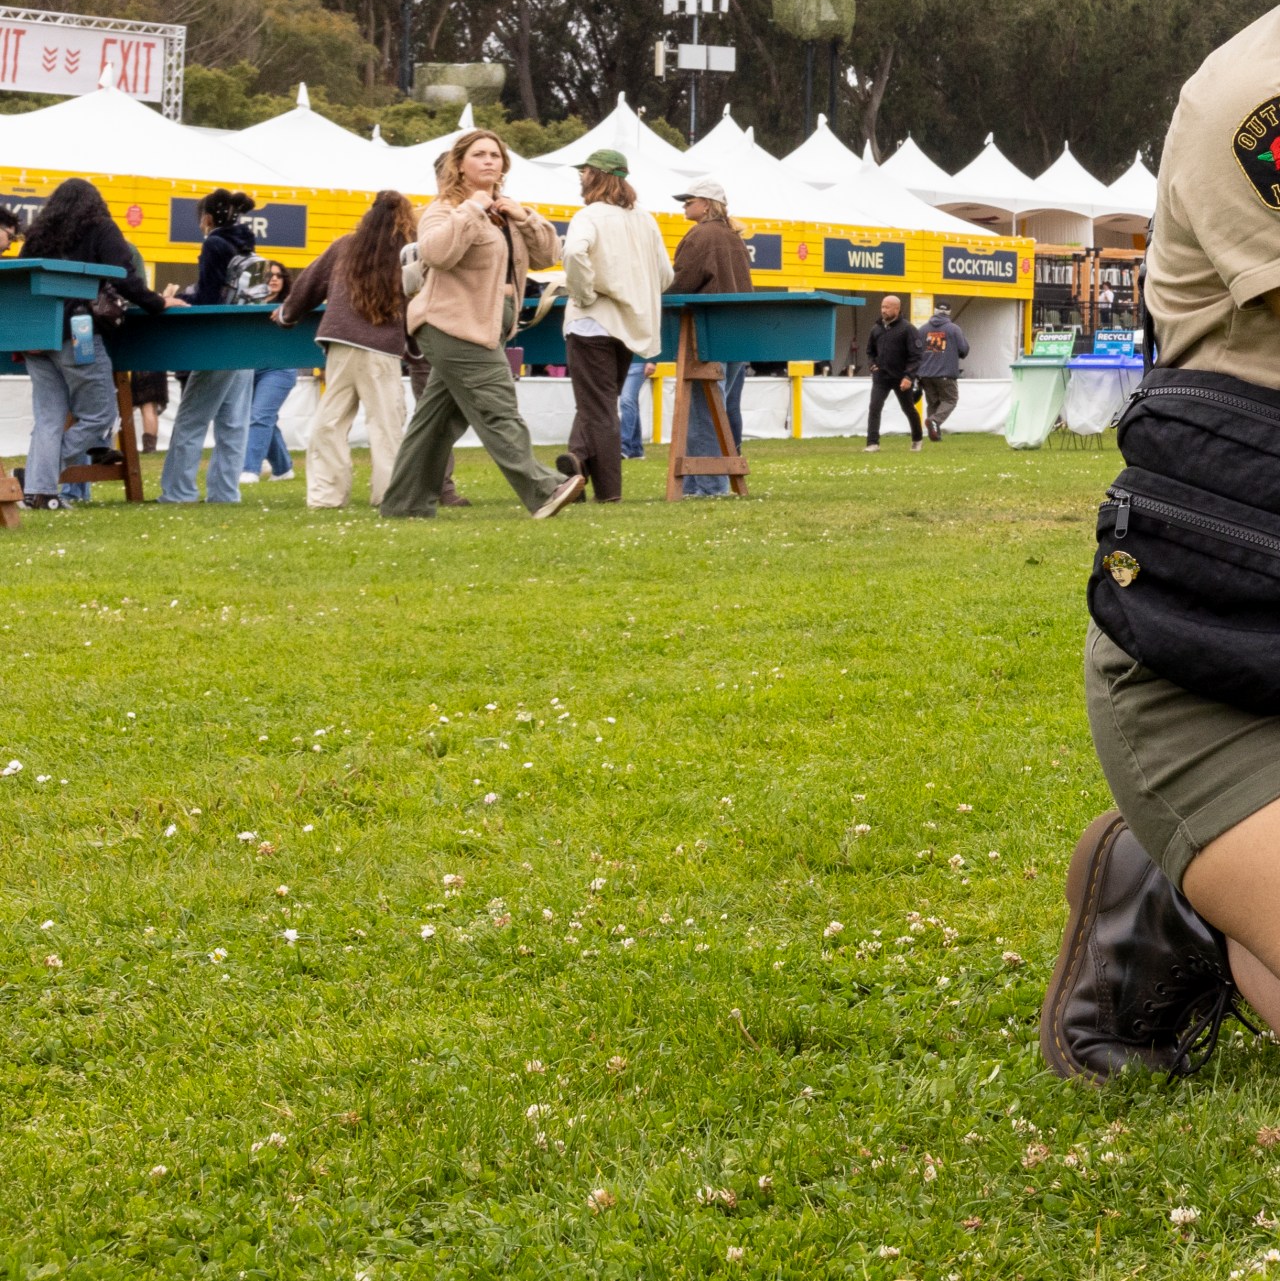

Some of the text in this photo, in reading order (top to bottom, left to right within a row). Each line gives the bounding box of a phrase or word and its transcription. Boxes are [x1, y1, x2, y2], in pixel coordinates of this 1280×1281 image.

[98, 37, 156, 94] EXIT
[848, 250, 884, 269] WINE
[947, 257, 1013, 277] COCKTAILS
